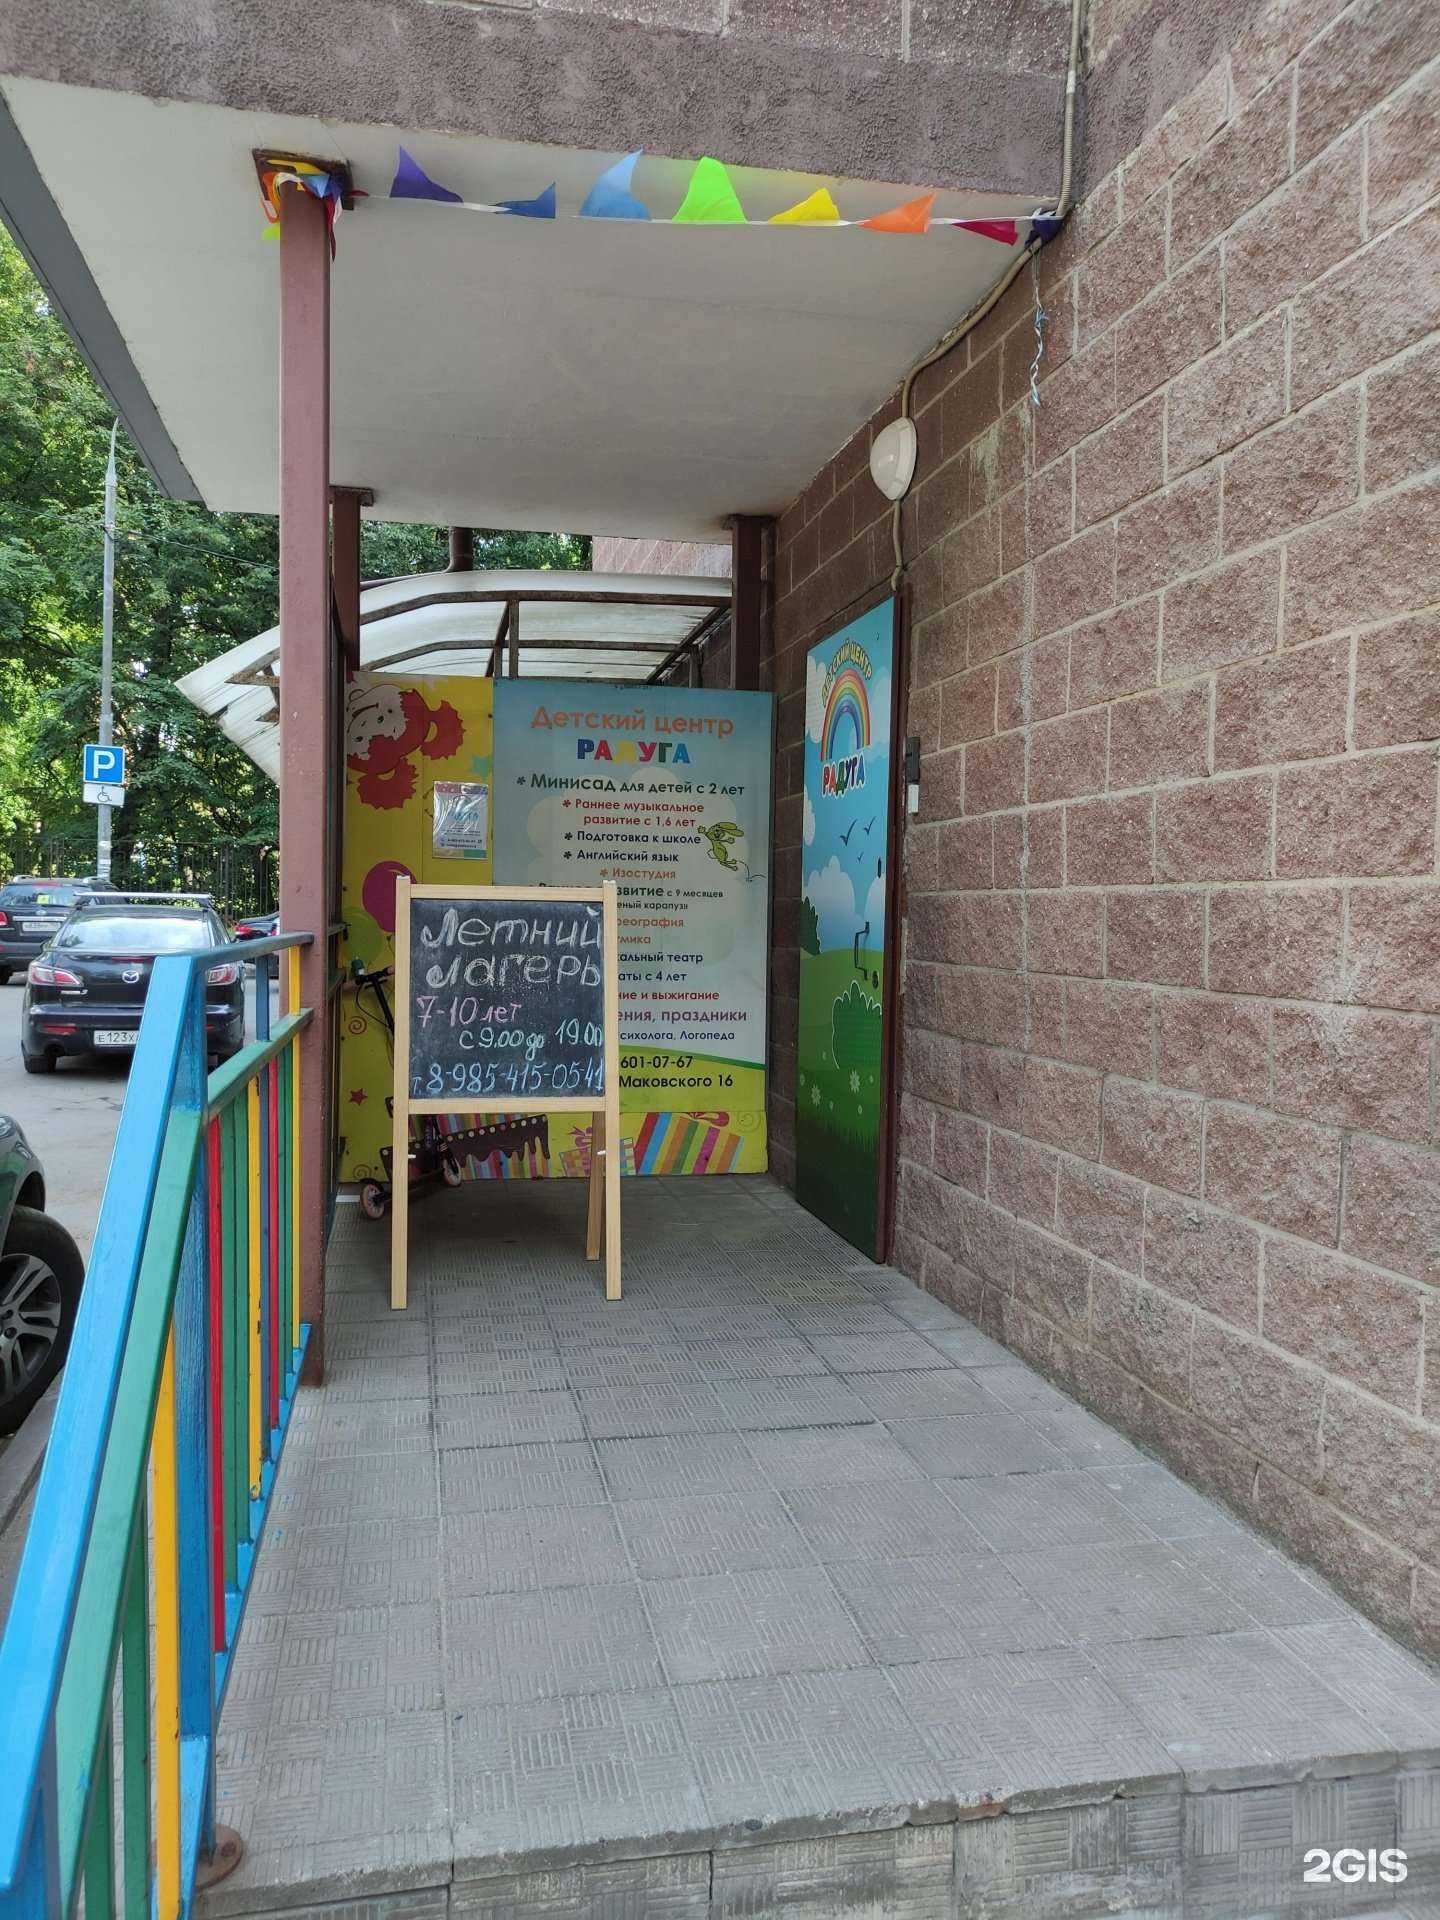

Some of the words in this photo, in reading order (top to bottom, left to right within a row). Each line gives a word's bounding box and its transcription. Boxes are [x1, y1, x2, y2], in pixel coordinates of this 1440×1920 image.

[530, 705, 645, 730] Детский
[655, 715, 734, 739] центр
[577, 738, 690, 765] РАДУГА
[93, 751, 115, 778] P
[823, 756, 865, 795] РАДУГА
[530, 773, 616, 792] Минисад
[620, 782, 644, 792] для
[648, 781, 692, 794] детей
[696, 784, 705, 794] с
[709, 783, 717, 794] 2
[720, 785, 745, 795] лет
[575, 798, 621, 810] Раннее
[623, 801, 705, 813] музыкальное
[583, 815, 641, 826] развитие
[644, 817, 652, 826] с
[675, 818, 696, 827] лет
[577, 830, 649, 843] Подготовка
[652, 834, 659, 843] к
[662, 835, 701, 844] школе
[577, 849, 648, 861] Английский
[651, 853, 680, 862] язык
[612, 868, 676, 880] Изостудия
[616, 886, 664, 897] звитие
[675, 888, 681, 897] 9
[683, 890, 724, 898] месяцев
[617, 901, 641, 909] еный
[618, 935, 652, 944] мика
[618, 951, 664, 962] альный
[666, 953, 704, 964] театр
[618, 973, 641, 981] аты
[645, 973, 652, 981] с
[655, 971, 662, 981] 4
[666, 973, 687, 981] лет
[641, 992, 648, 1000] и
[651, 992, 720, 1000] выжигание
[416, 995, 478, 1028] 7-10
[480, 1002, 522, 1023] лет
[617, 1010, 656, 1023] ения,
[661, 1010, 748, 1024] праздники
[619, 1031, 676, 1041] сихолога,
[680, 1030, 735, 1041] Логопеда
[525, 1033, 545, 1061] до
[620, 1055, 693, 1069] 601-07-67
[618, 1075, 712, 1088] Маковского
[718, 1074, 734, 1087] 16
